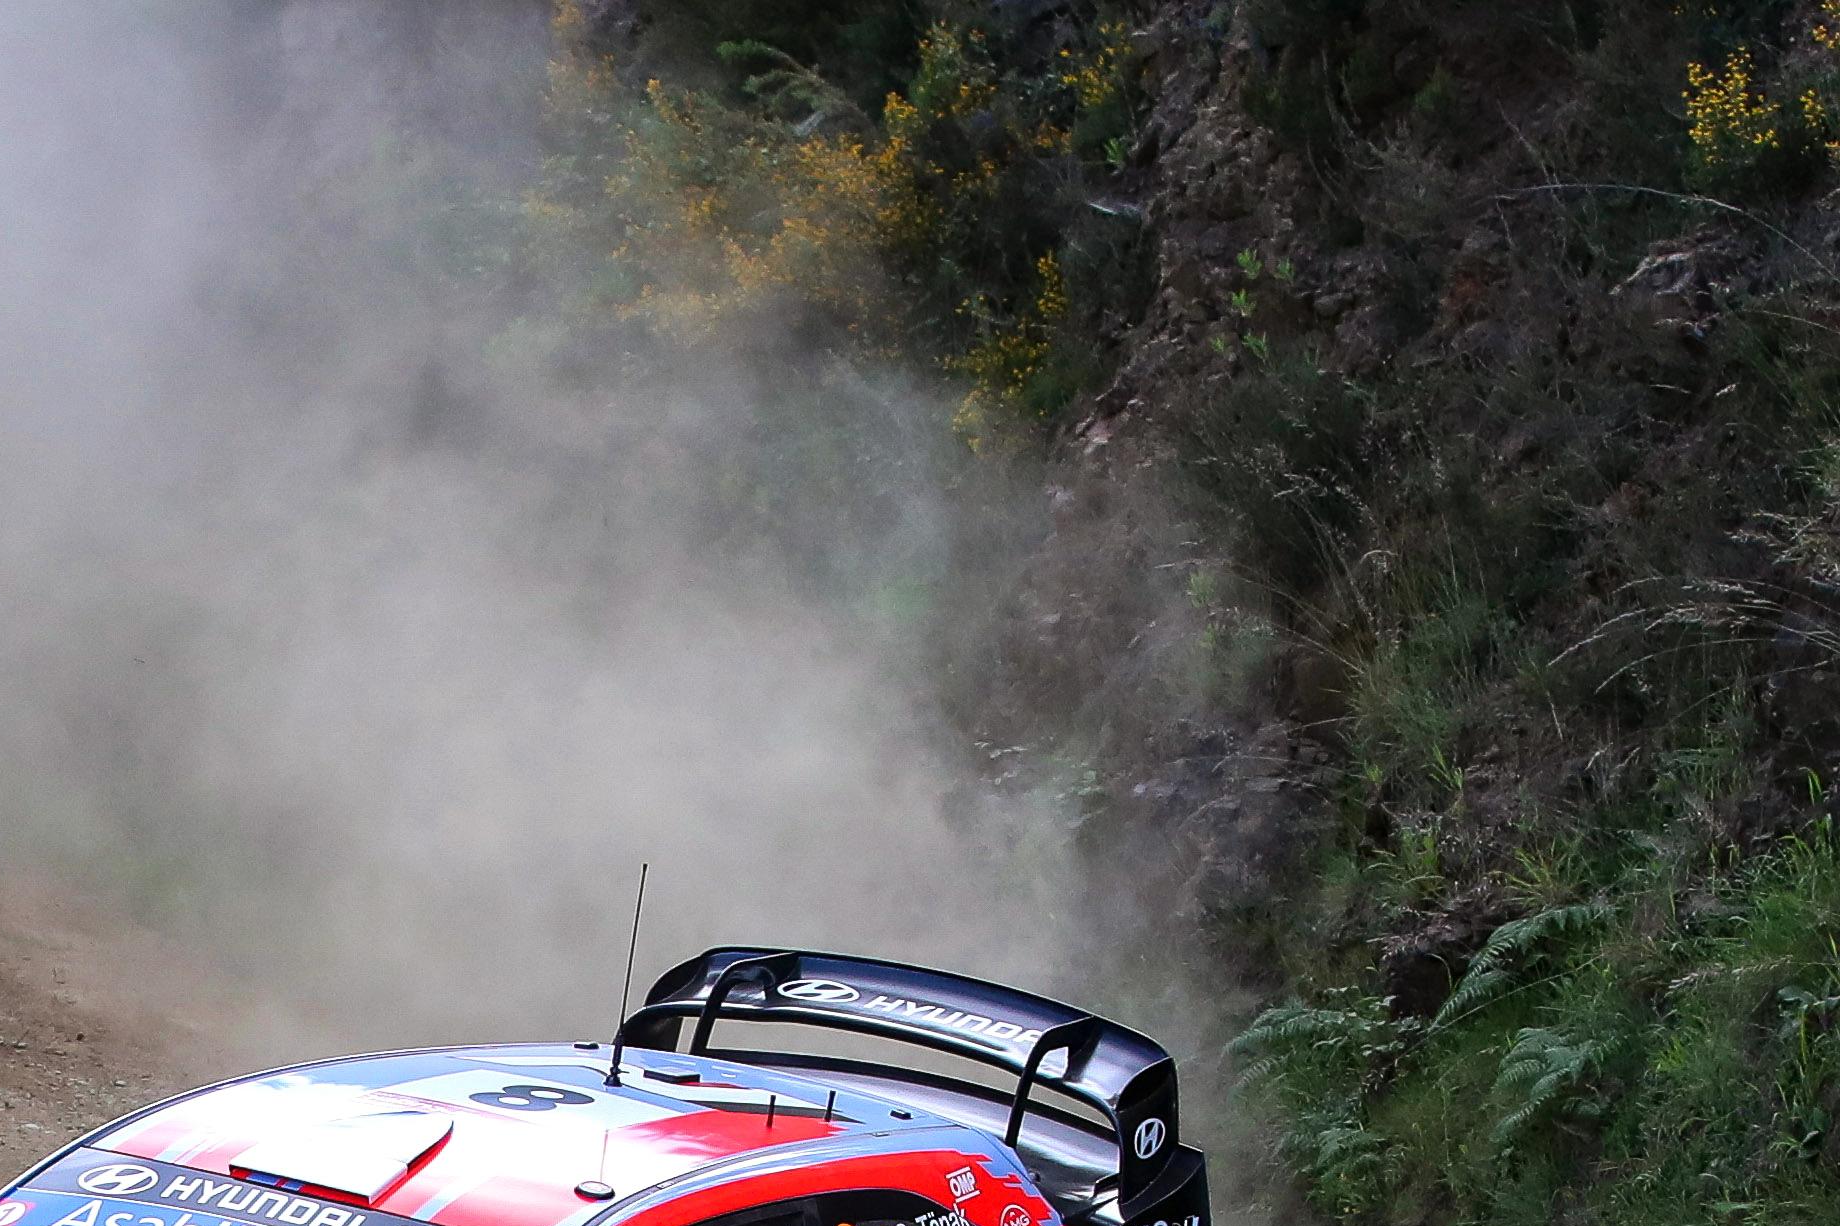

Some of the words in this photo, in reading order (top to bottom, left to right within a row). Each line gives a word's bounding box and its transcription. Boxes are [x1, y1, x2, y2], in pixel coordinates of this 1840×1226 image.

[864, 995, 1043, 1044] HYUNDA
[469, 1084, 596, 1112] 8
[949, 1170, 977, 1199] OMP
